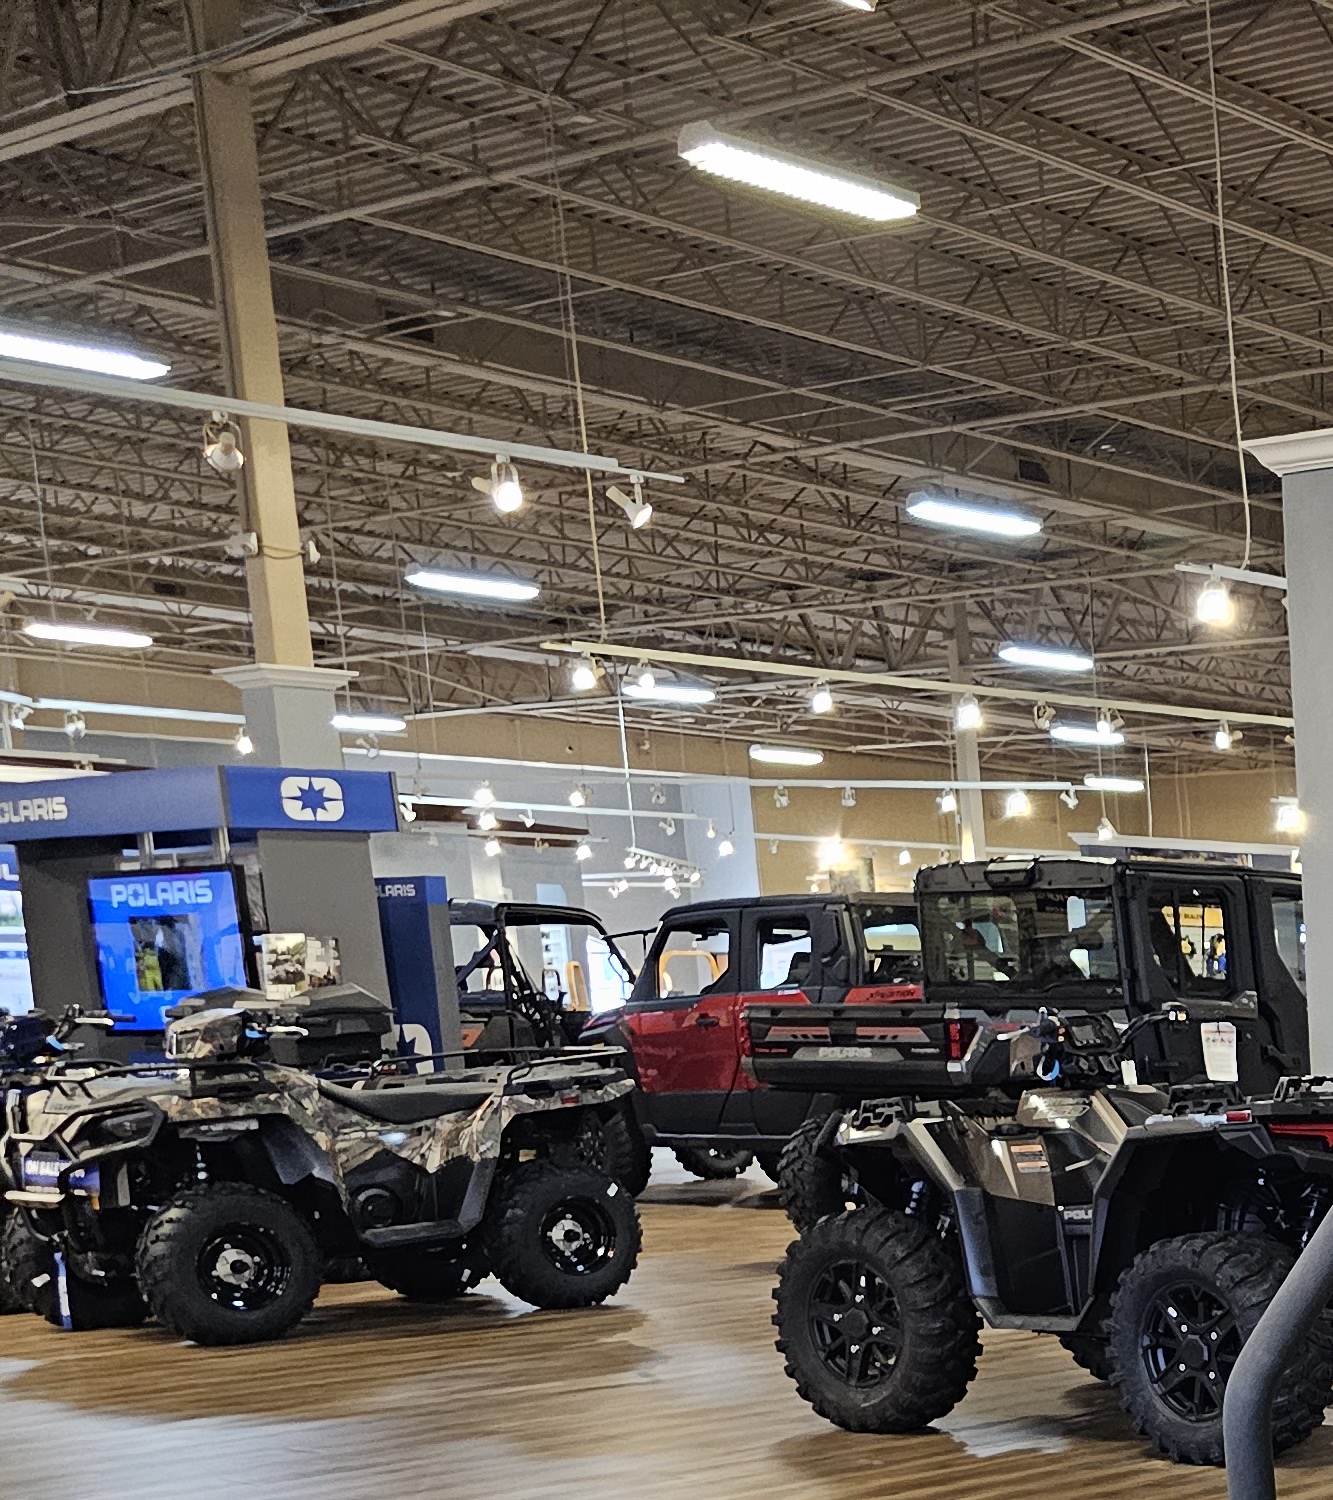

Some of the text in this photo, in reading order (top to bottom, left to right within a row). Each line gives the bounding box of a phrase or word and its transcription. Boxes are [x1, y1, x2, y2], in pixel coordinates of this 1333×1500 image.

[110, 879, 214, 908] POLARIS
[378, 883, 416, 898] LARIS
[1063, 1209, 1093, 1221] POL
